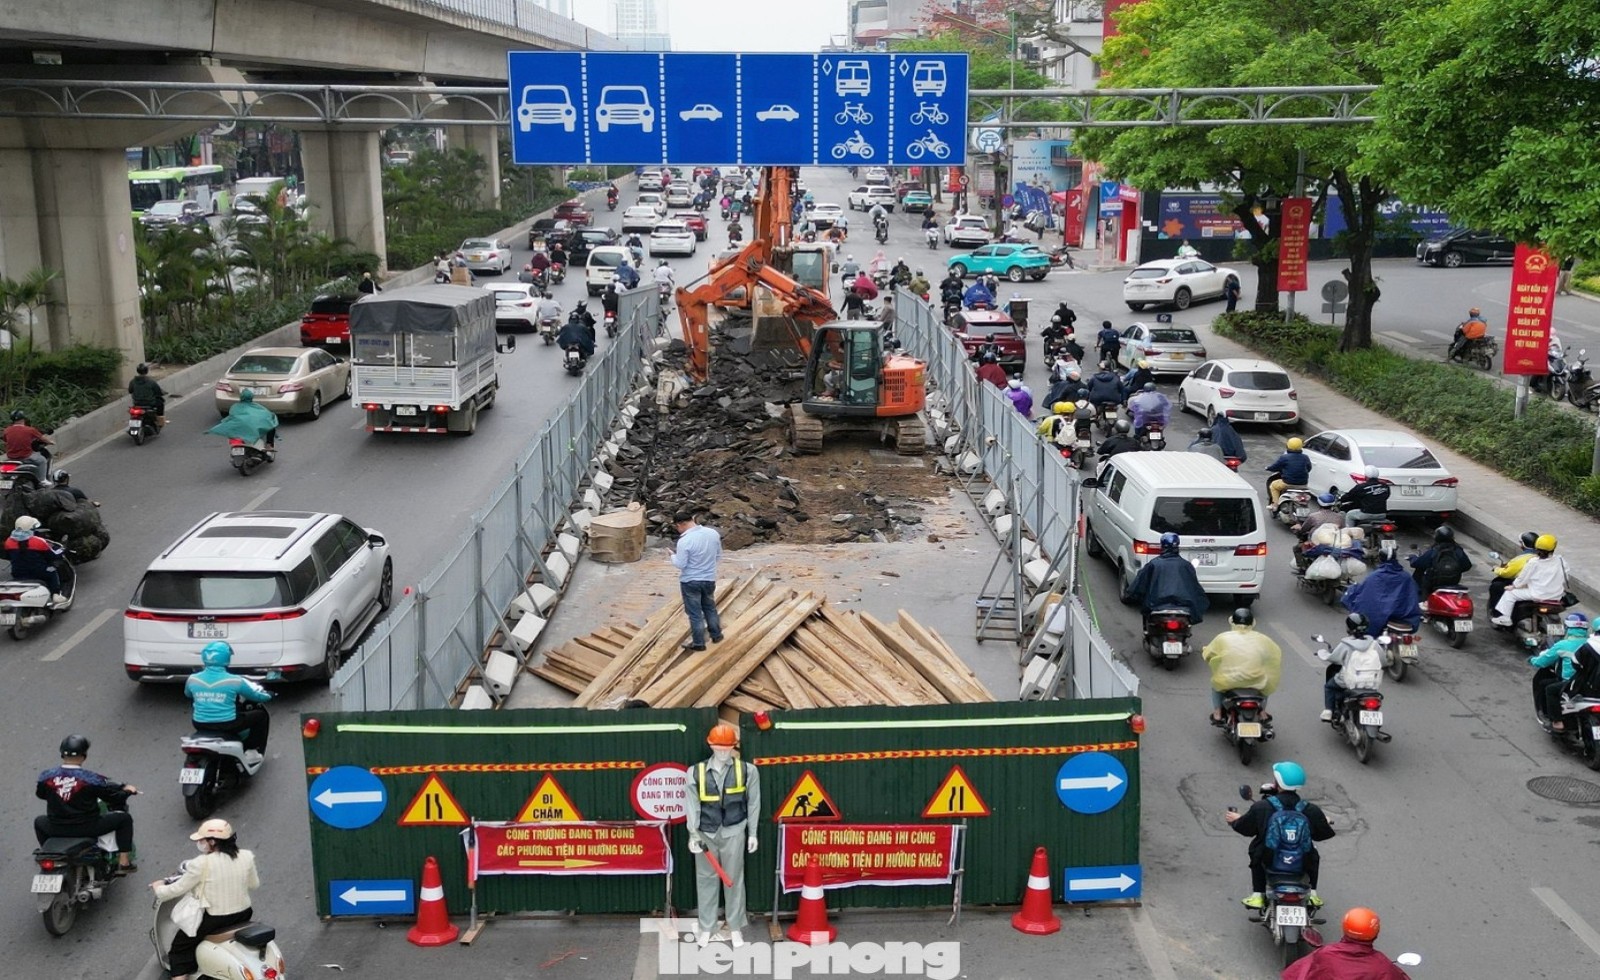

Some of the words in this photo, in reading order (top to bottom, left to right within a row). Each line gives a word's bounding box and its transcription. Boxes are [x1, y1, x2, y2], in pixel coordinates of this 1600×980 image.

[642, 776, 663, 786] CÔNG
[542, 793, 553, 804] ĐI
[641, 790, 661, 799] ĐANG
[662, 790, 674, 799] THI
[506, 827, 530, 840] CÔNG
[568, 828, 593, 840] ĐANG
[594, 828, 609, 840] THI
[610, 827, 635, 839] CÔNG
[801, 827, 827, 845] CÔNG
[867, 830, 892, 845] ĐANG
[894, 830, 908, 844] THI
[910, 828, 936, 845] CÔNG
[497, 843, 515, 857] CÁC
[517, 844, 553, 857] PHƯƠNG
[555, 842, 575, 858] TIỆN
[576, 844, 586, 856] ĐI
[852, 849, 872, 871] TIỆN
[874, 852, 884, 868] ĐI
[918, 848, 943, 868] KHÁC
